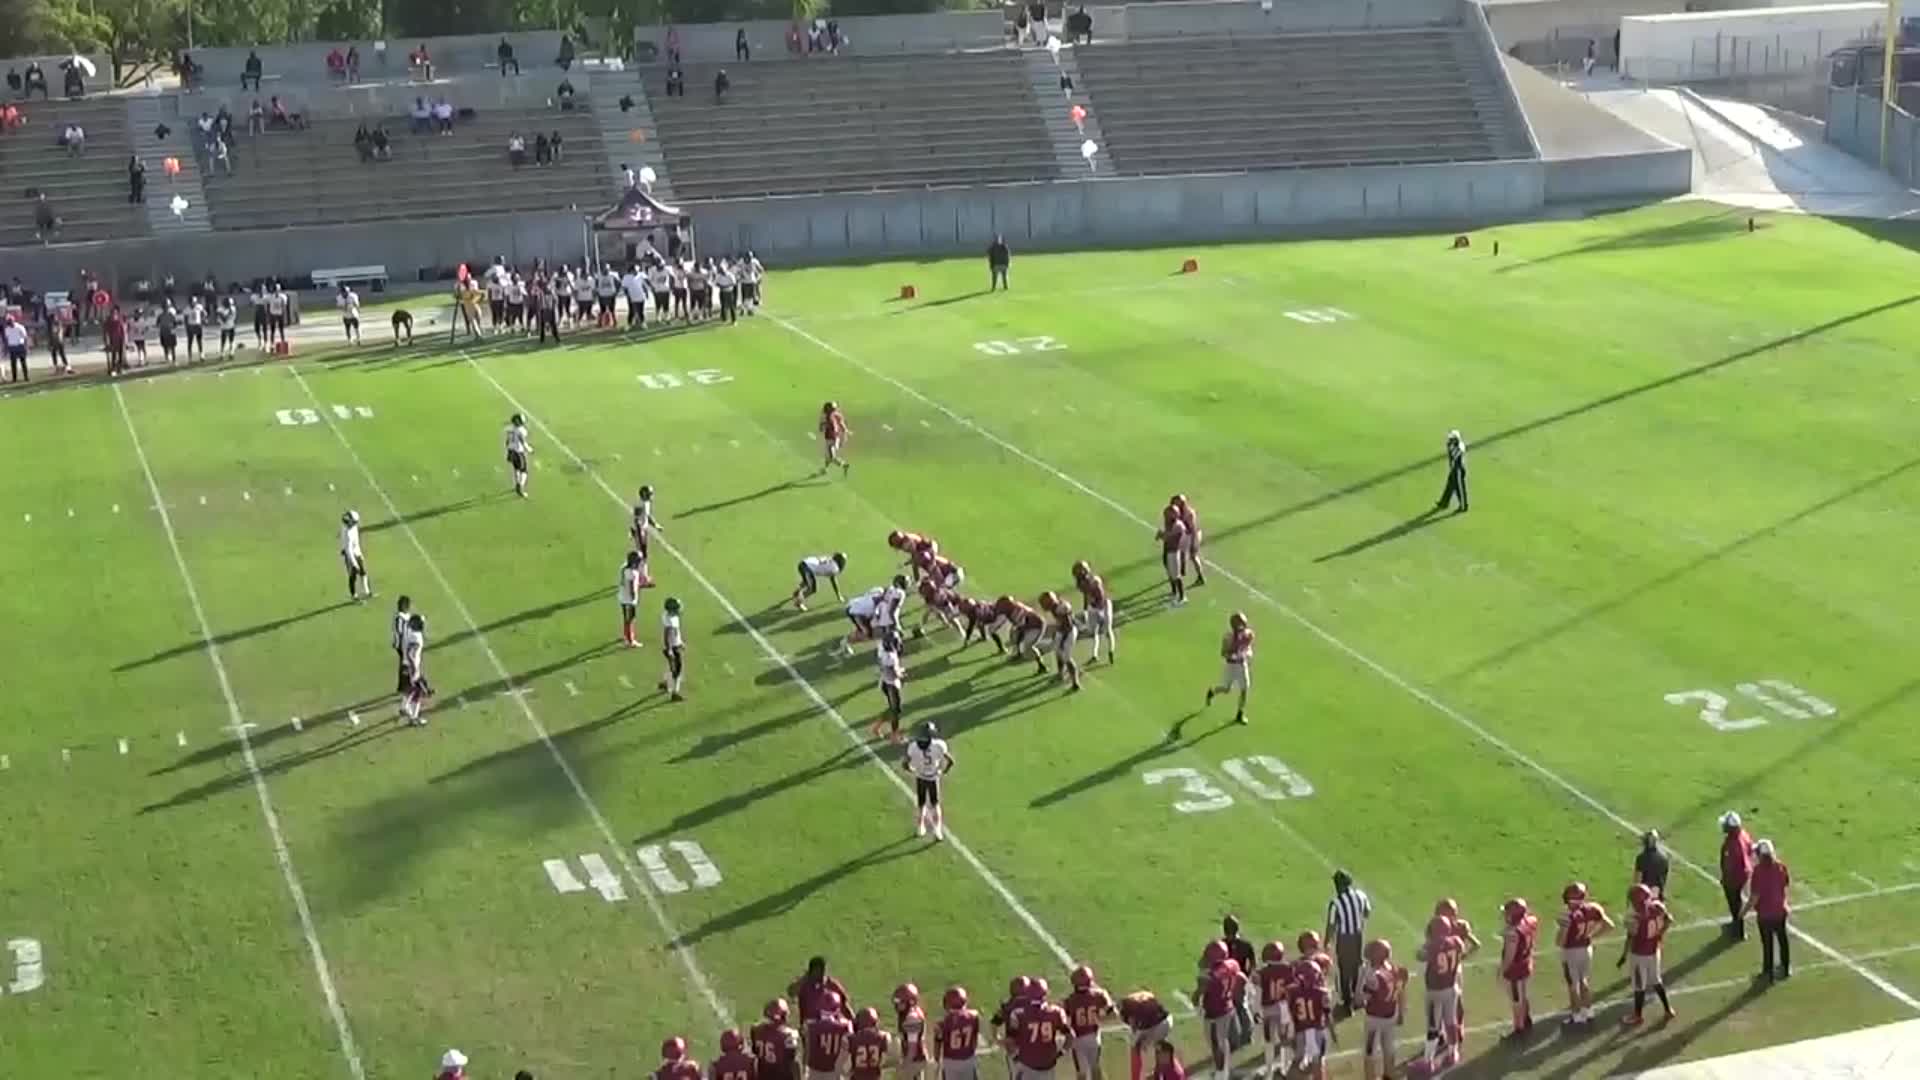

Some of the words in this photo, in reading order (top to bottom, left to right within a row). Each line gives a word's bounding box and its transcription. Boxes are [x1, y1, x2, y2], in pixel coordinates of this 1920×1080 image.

[1664, 679, 1837, 731] 20
[1141, 756, 1315, 813] 30
[543, 841, 723, 901] 40
[1076, 1006, 1100, 1026] 66
[1296, 997, 1316, 1020] 31
[820, 1032, 840, 1055] 41
[951, 1024, 973, 1050] 67
[1028, 1022, 1052, 1043] 79
[855, 1045, 880, 1068] 23
